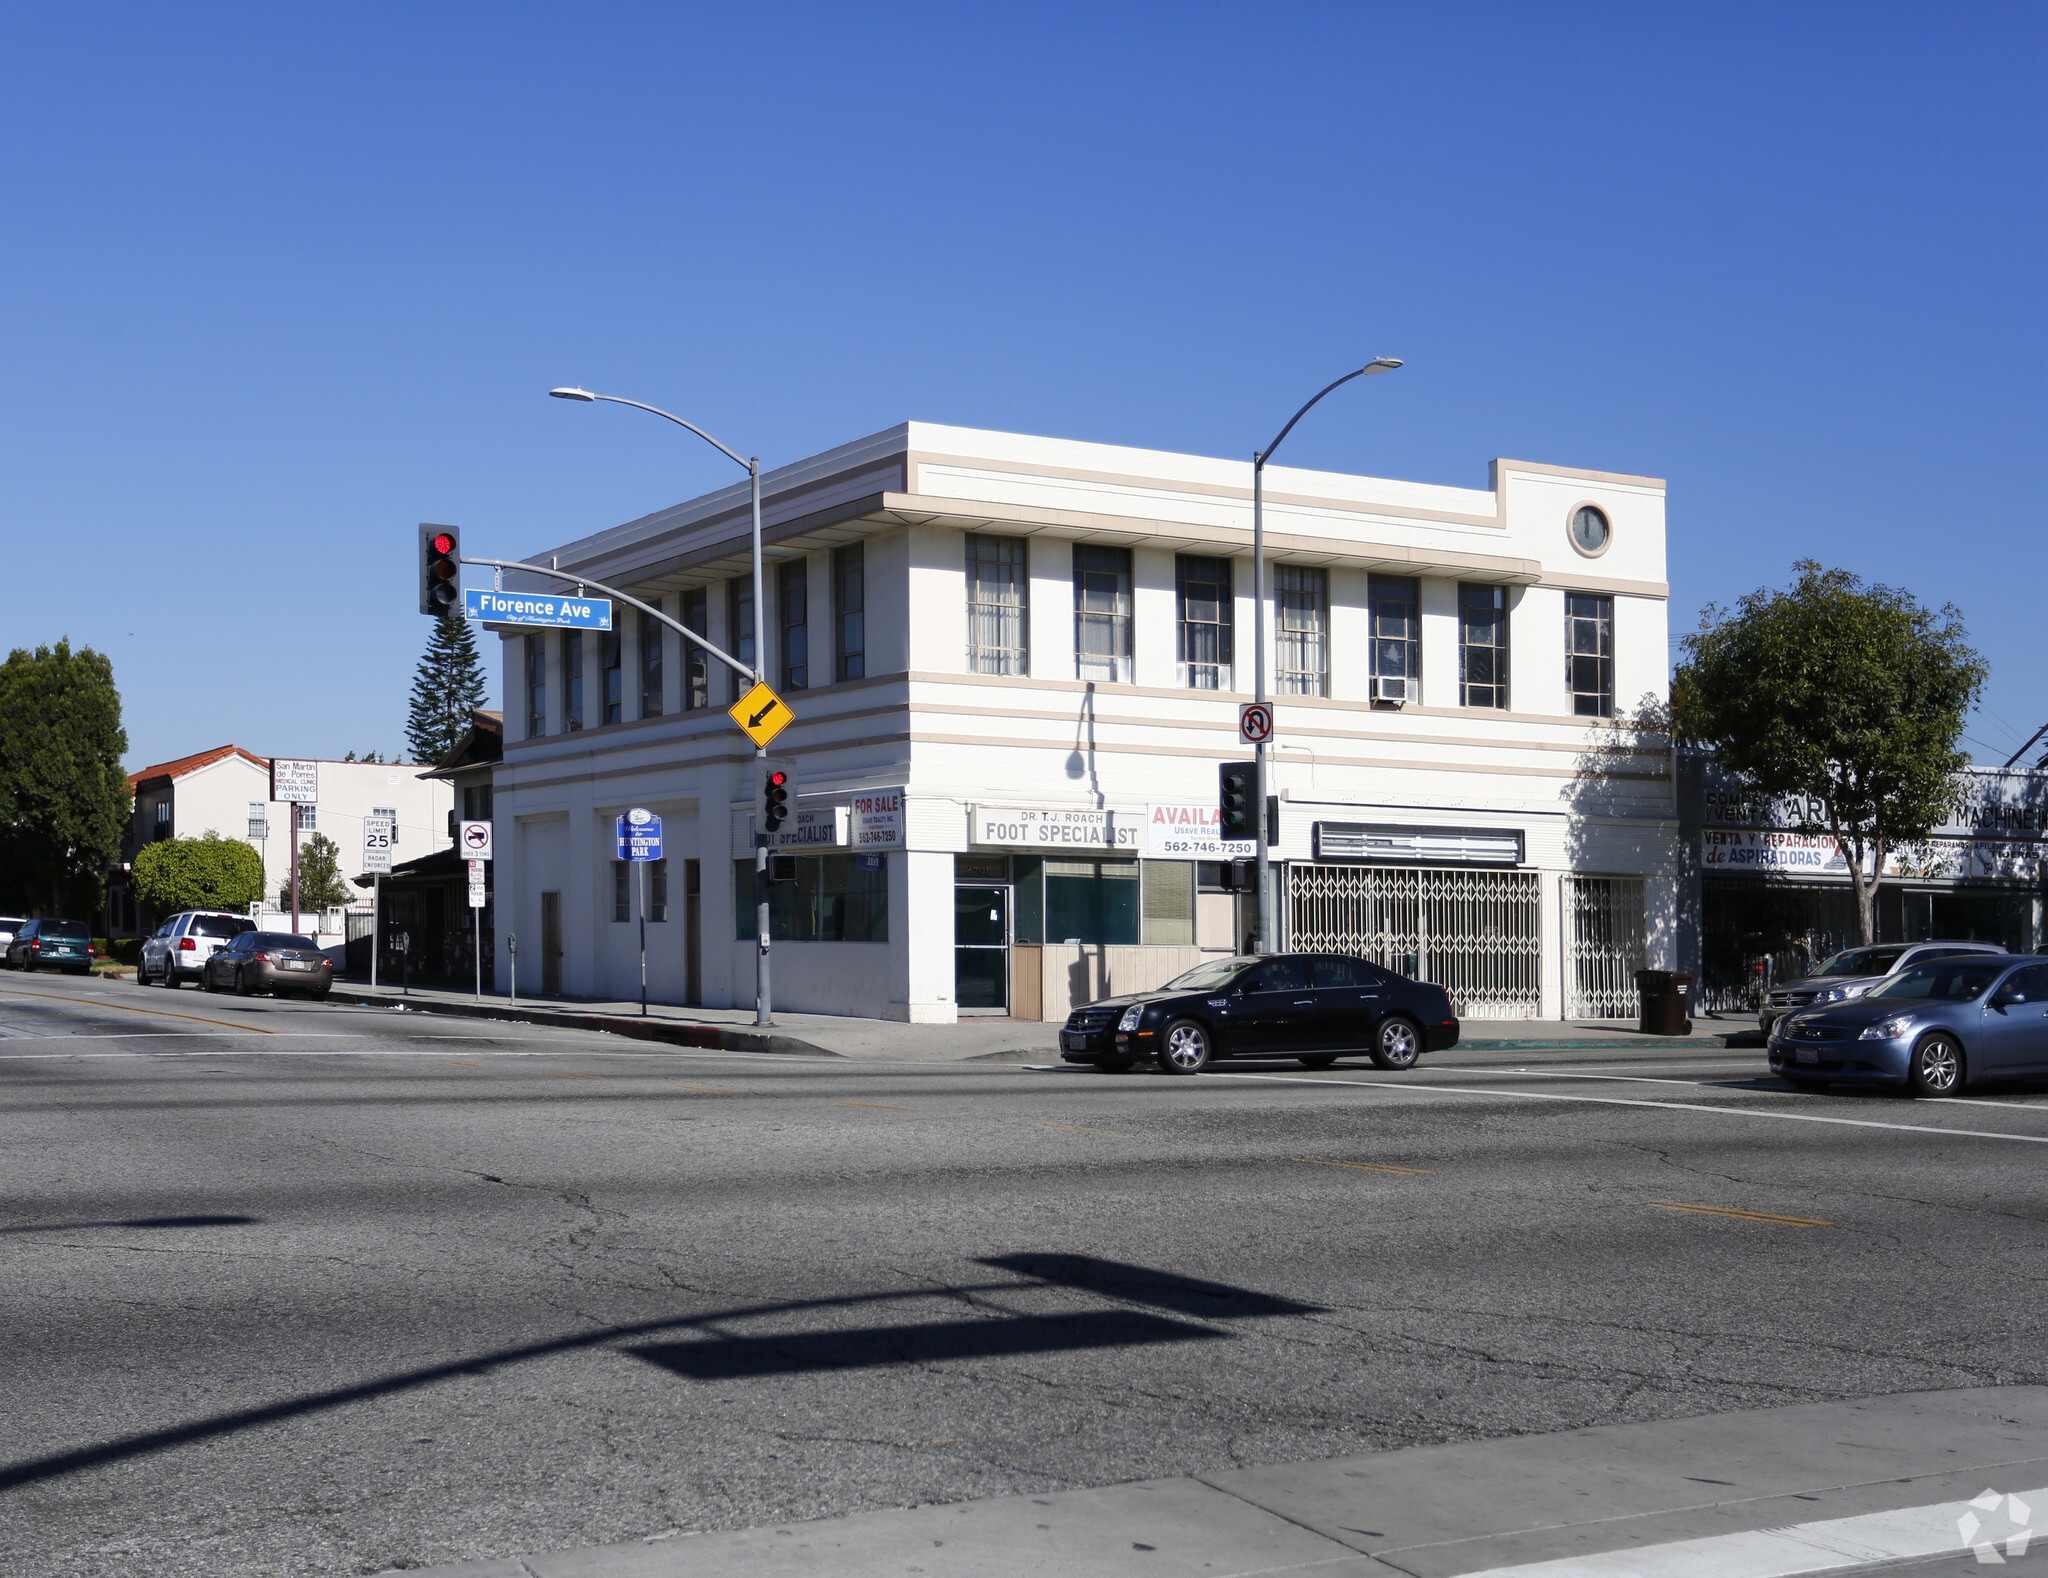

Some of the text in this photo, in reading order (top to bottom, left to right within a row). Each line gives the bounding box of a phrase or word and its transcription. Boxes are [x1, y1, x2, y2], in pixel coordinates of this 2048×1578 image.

[480, 595, 591, 618] Florence Ave
[507, 614, 517, 622] City
[526, 616, 556, 624] Huntington
[276, 761, 316, 770] San Martin
[291, 770, 316, 778] Porres
[276, 784, 316, 792] PARKING
[855, 795, 899, 814] FOR SALE
[798, 814, 814, 824] OACH
[1021, 811, 1038, 821] DR.
[1065, 813, 1103, 823] ROACH
[1152, 806, 1221, 825] AVAILA
[1956, 805, 2034, 829] MACHINE
[859, 830, 896, 843] 562-746-7250
[986, 822, 1138, 845] FOOT SPECIALIST
[1201, 827, 1221, 835] REAL
[367, 834, 389, 847] 25
[619, 837, 660, 847] HUNTINGTON
[1704, 831, 1836, 849] VENTA Y REPARACION
[1931, 841, 1969, 849] REPARAMOS
[631, 847, 650, 857] PARK
[1164, 841, 1251, 853] 562-746-7250
[1974, 842, 2011, 851] AFILAMOS
[1706, 846, 1821, 866] de ASPIRADORAS
[1990, 851, 2040, 860] TIJERAS
